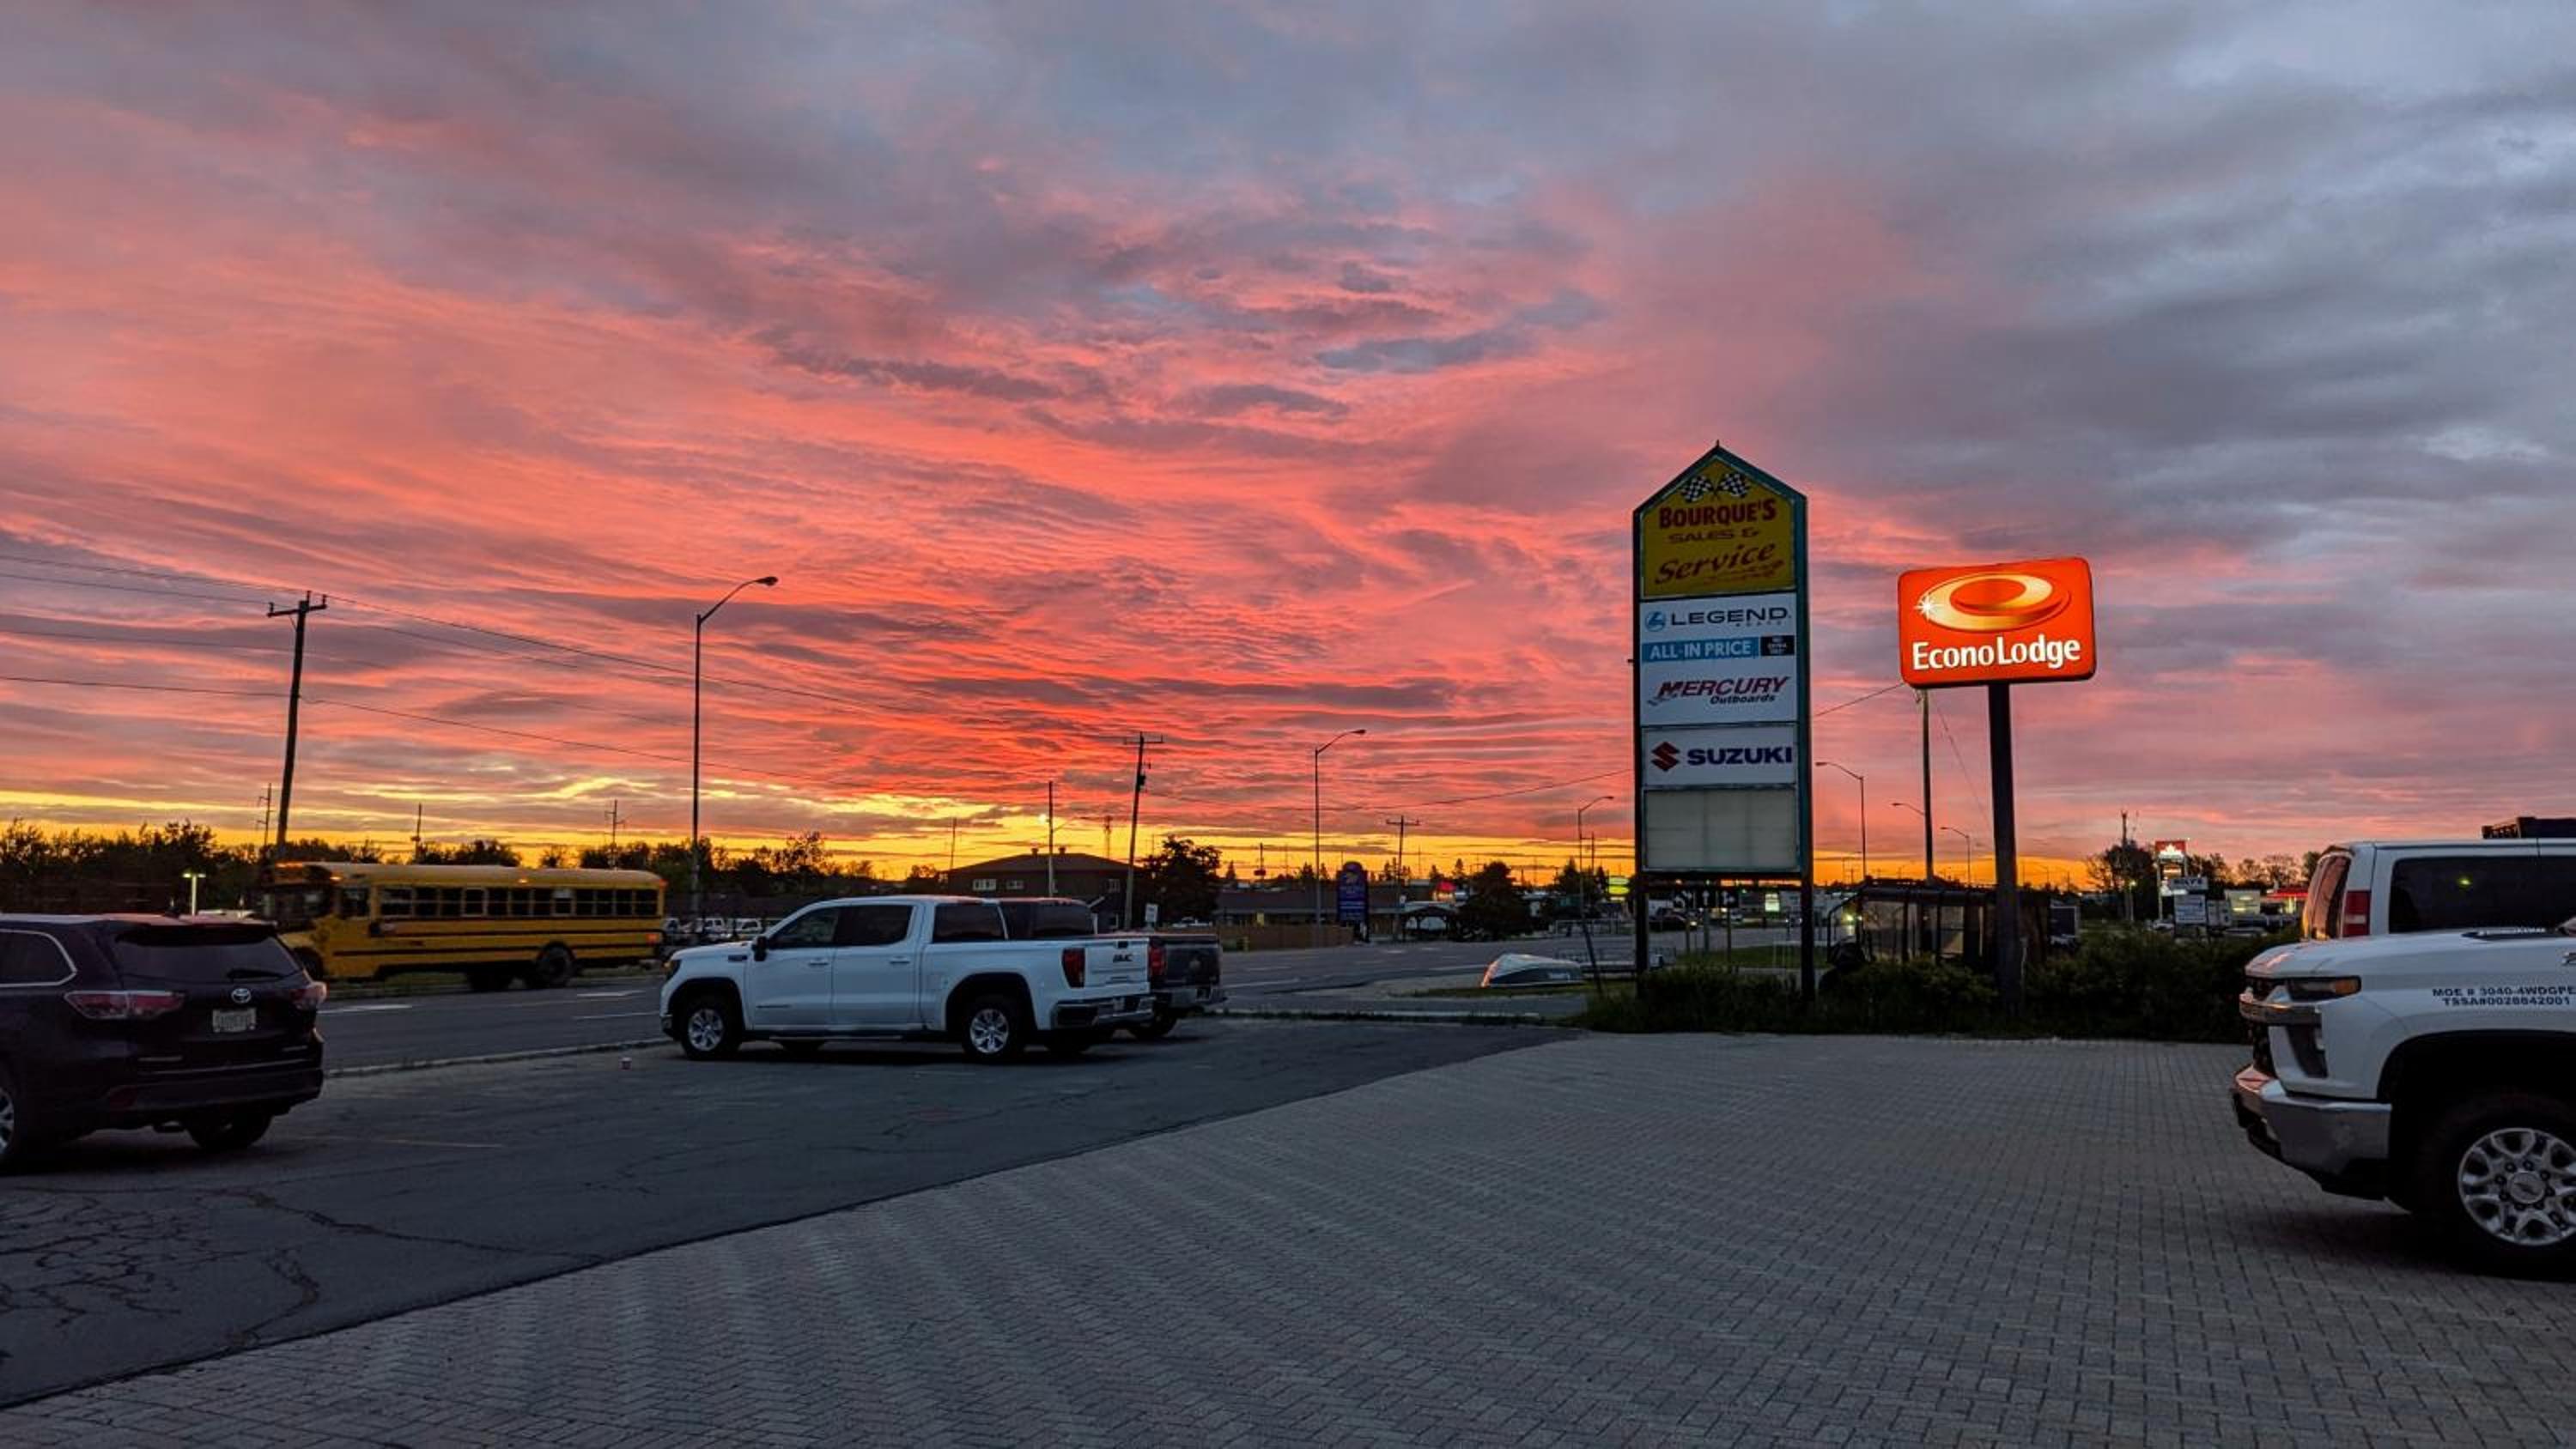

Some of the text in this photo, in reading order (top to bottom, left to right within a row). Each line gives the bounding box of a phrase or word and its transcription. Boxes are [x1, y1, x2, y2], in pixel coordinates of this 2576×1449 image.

[1659, 498, 1777, 530] BOURQUE'S
[1668, 528, 1735, 543] SALES
[1655, 543, 1777, 585] Service
[1671, 607, 1789, 626] LEGEND
[1704, 640, 1752, 658] PRICE
[1656, 676, 1791, 700] MERCURY
[1710, 693, 1776, 706] Outboards
[1687, 746, 1793, 766] SUZUKI
